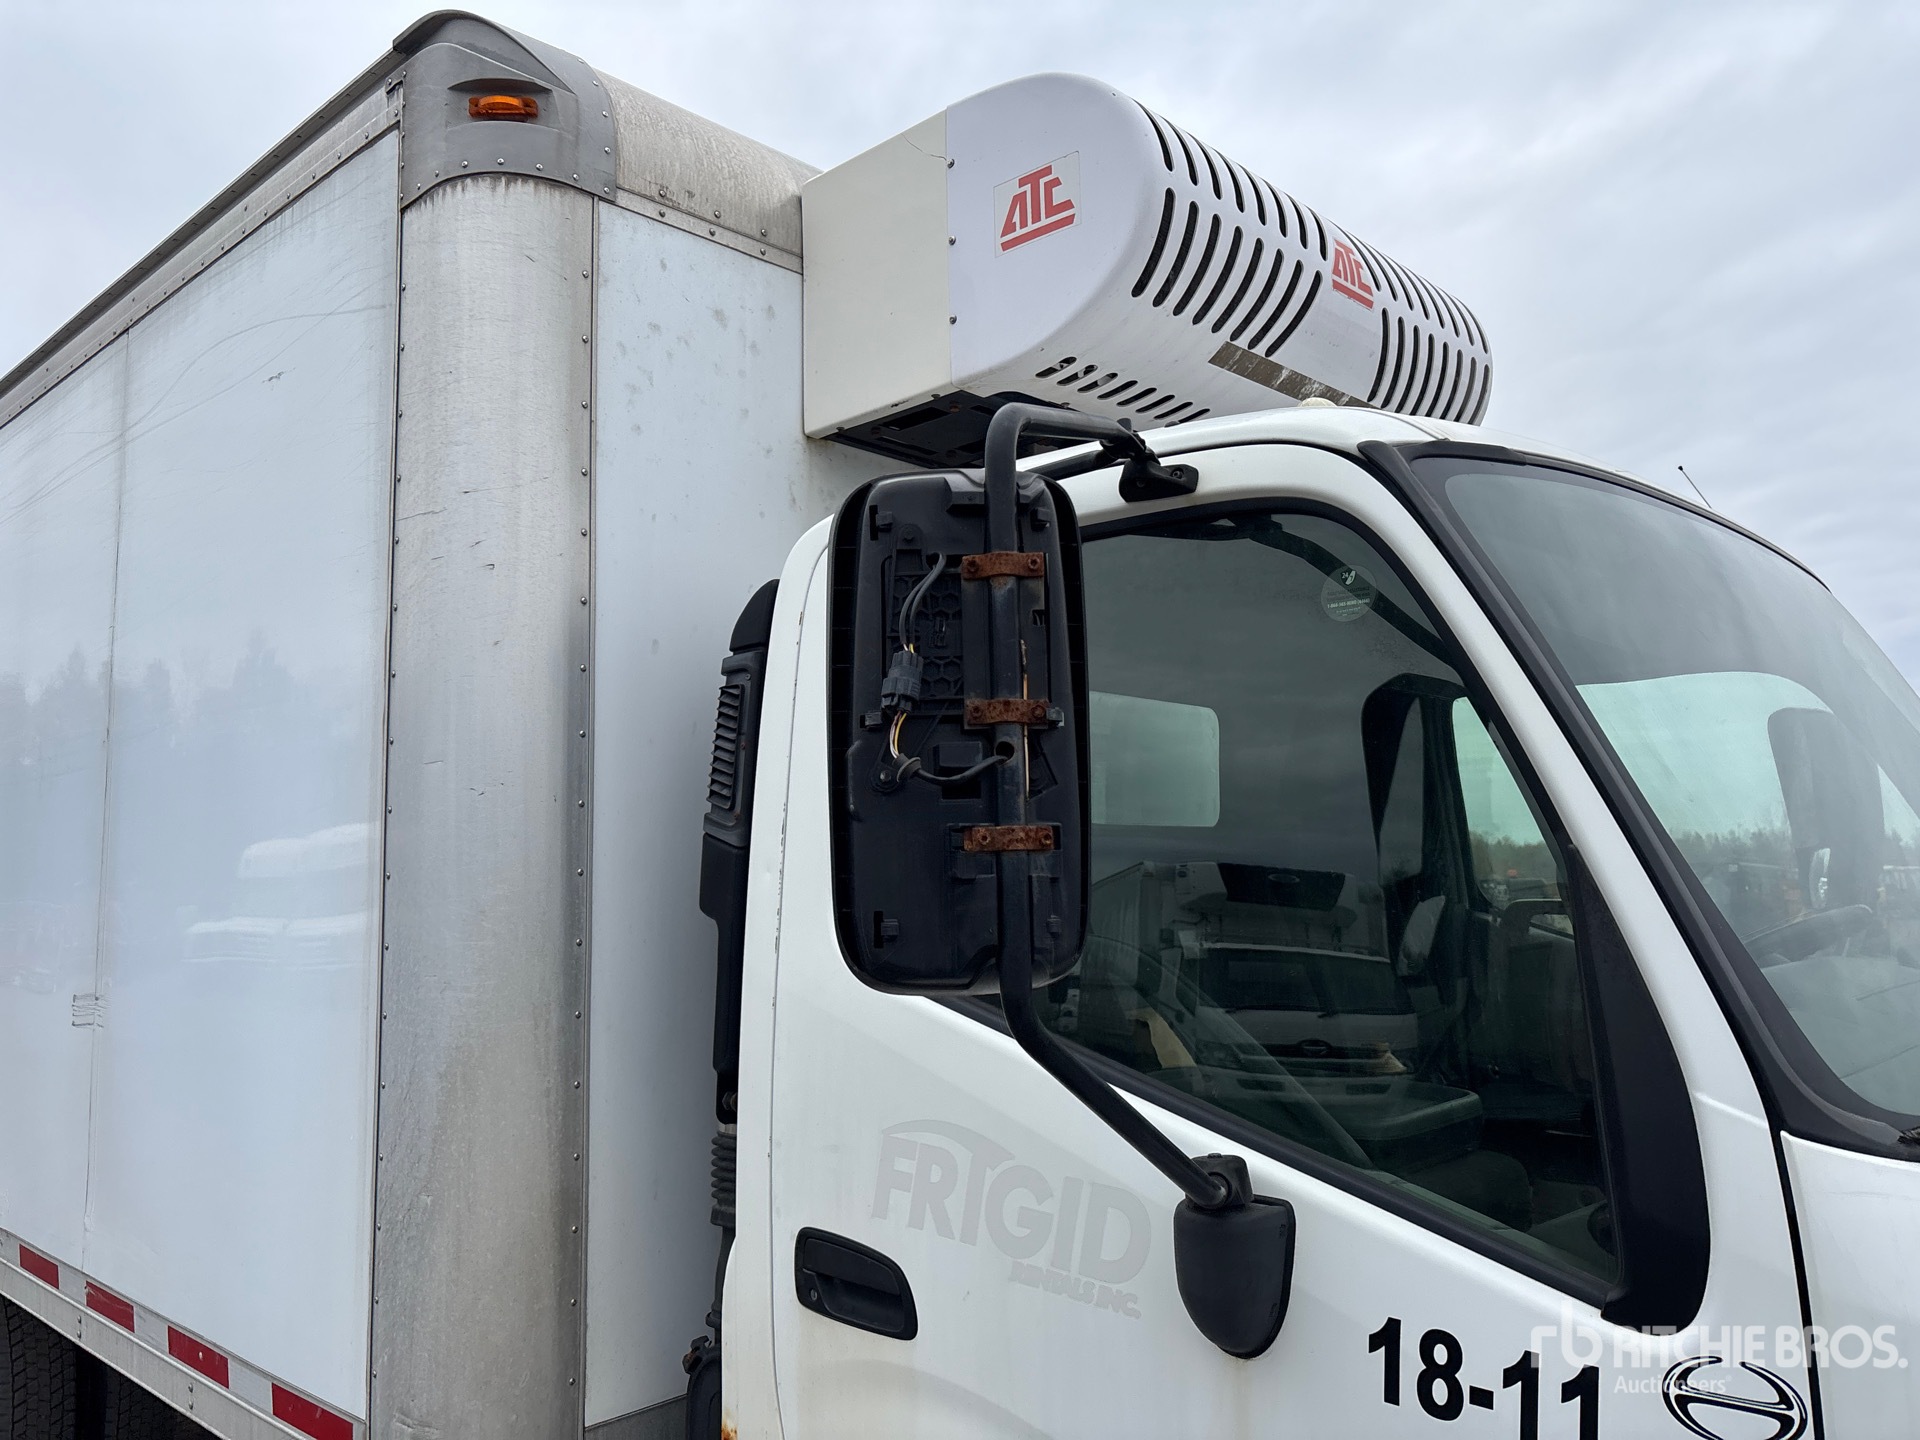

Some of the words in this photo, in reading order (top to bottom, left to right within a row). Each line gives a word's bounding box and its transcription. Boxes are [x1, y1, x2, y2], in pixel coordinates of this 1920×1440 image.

[1000, 164, 1075, 239] ATC
[1332, 239, 1373, 295] ATC
[1368, 1316, 1600, 1440] 18-11
